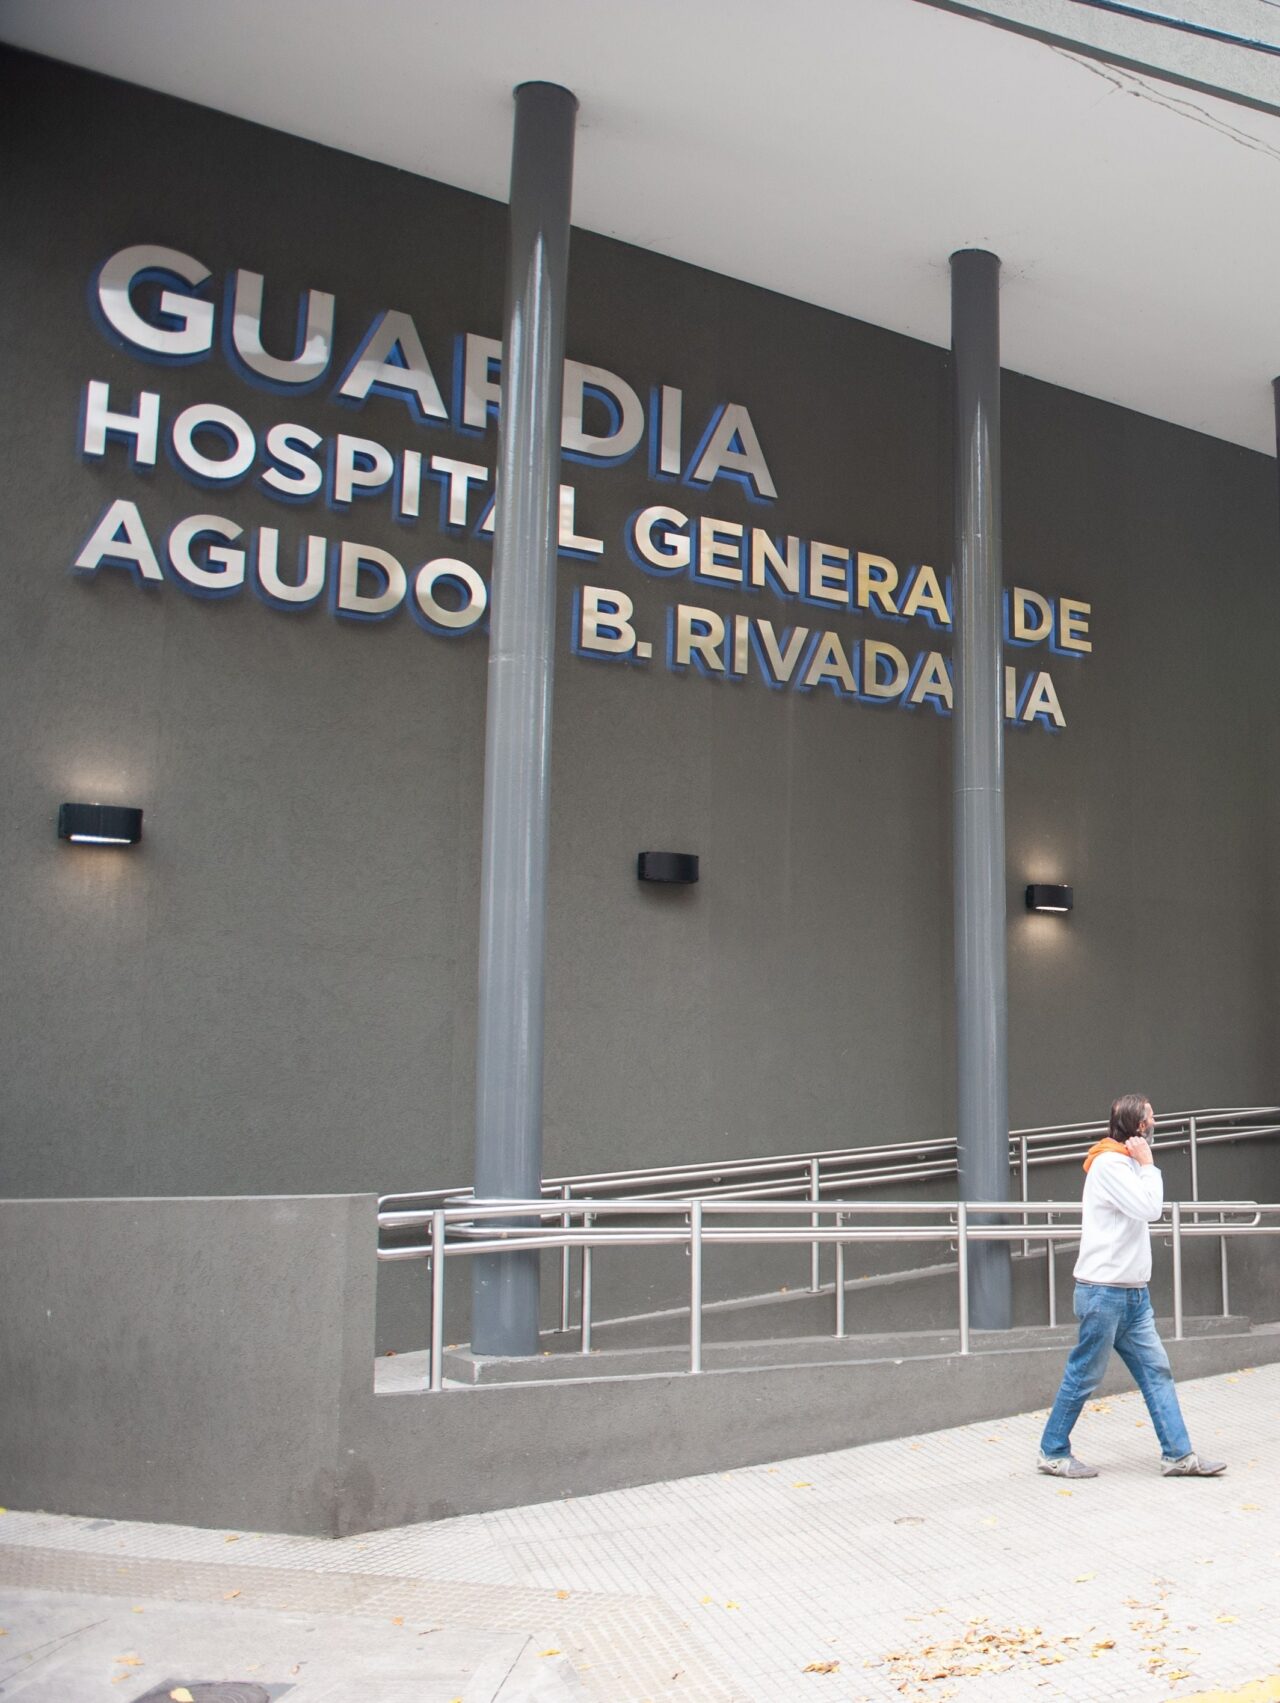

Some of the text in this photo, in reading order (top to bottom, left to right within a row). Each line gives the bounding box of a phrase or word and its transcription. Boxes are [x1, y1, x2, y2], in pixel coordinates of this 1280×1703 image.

[83, 380, 1093, 653] HOSPITL GENERA DE
[582, 584, 653, 659] B.
[676, 603, 1068, 728] RIVADAIA
